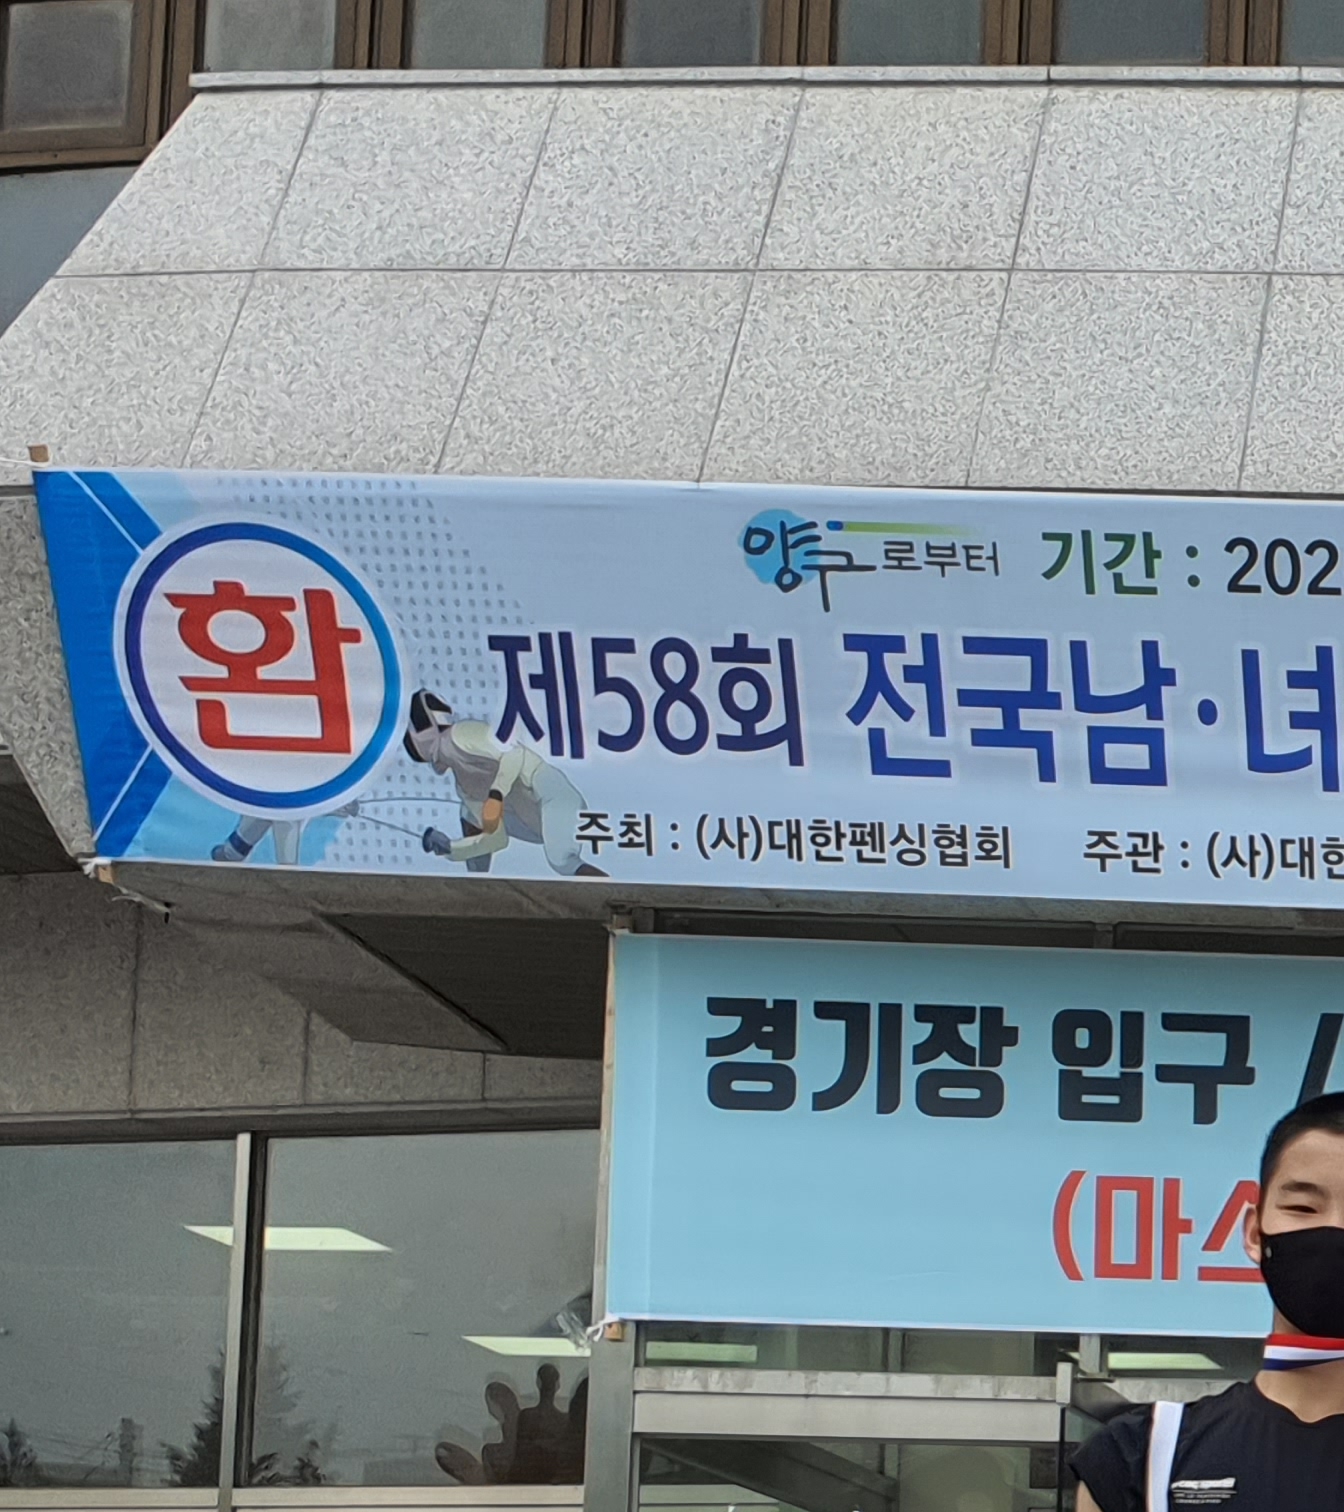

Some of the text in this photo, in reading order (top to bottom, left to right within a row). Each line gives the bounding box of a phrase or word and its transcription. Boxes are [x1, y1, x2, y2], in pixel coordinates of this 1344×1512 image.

[1041, 530, 1162, 595] 기간
[163, 579, 361, 756] 환
[485, 632, 805, 767] 제58회
[575, 812, 654, 857] 주최
[696, 813, 1011, 869] (사)대한펜싱협회
[1083, 830, 1164, 874] 주관
[705, 997, 1019, 1118] 경기장
[1052, 1009, 1255, 1125] 입구
